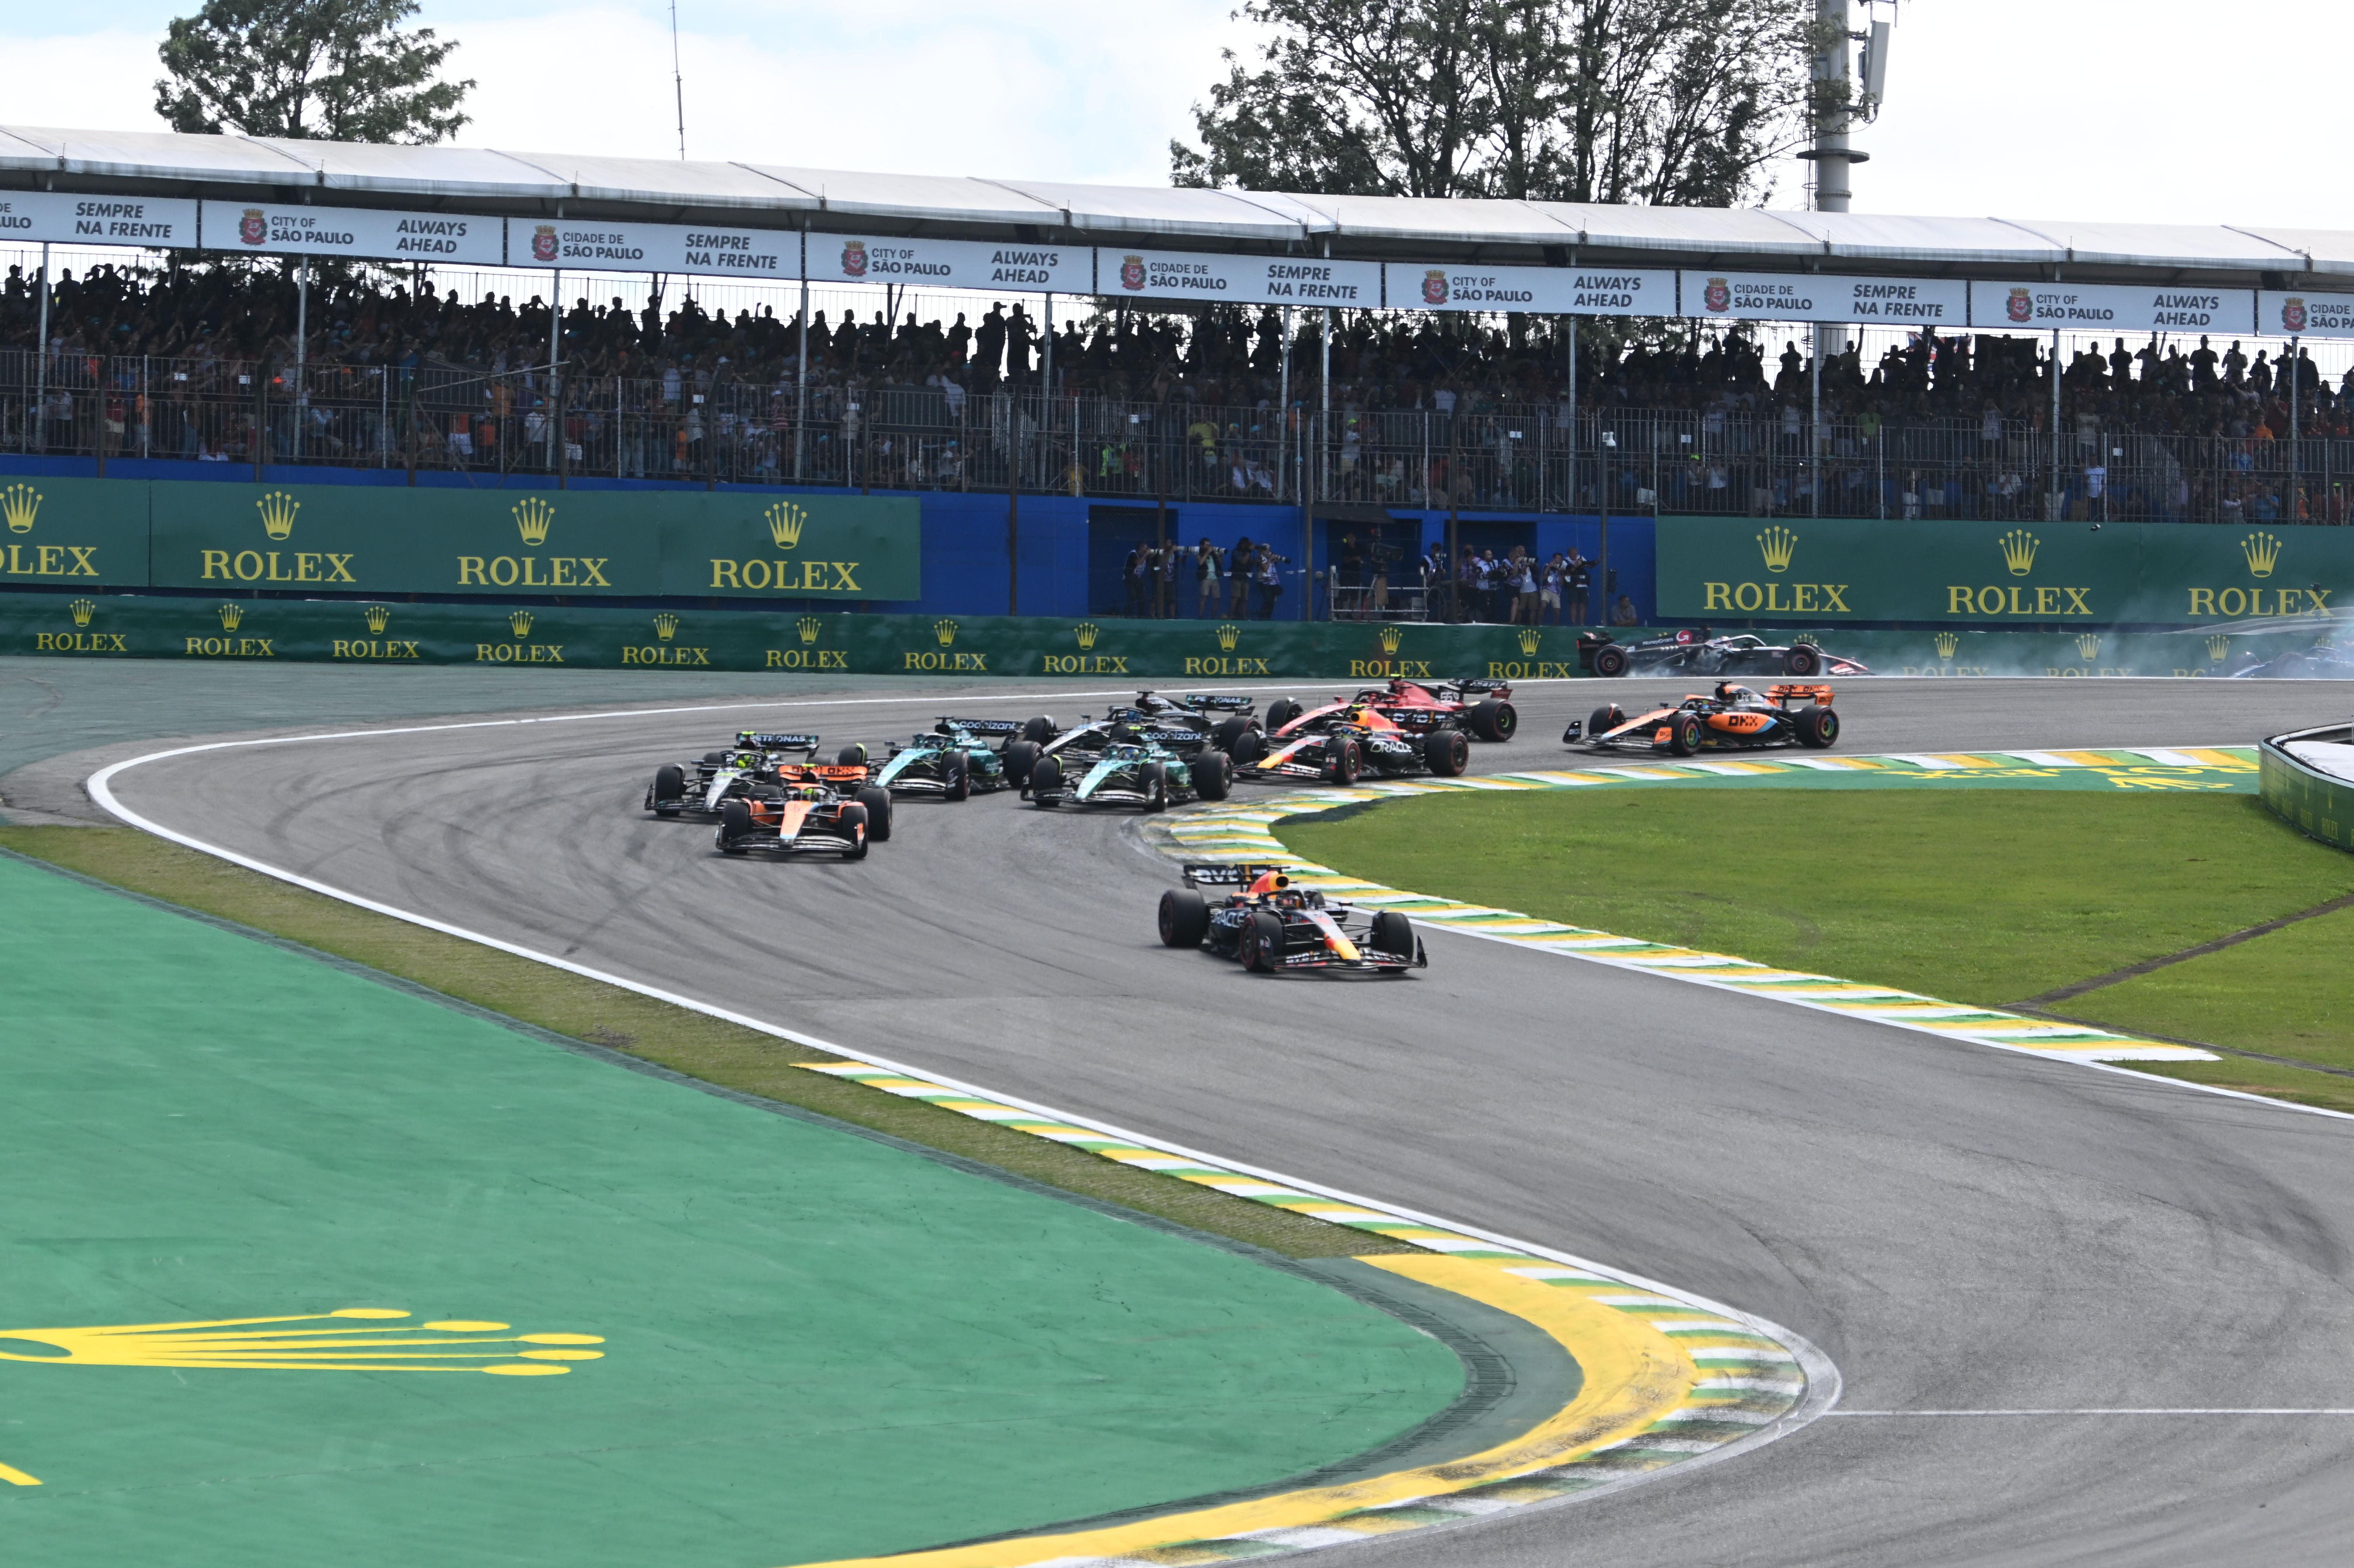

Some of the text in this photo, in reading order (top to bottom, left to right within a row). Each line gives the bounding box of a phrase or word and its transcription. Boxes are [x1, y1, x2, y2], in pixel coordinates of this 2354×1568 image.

[75, 202, 144, 219] SEMPRE
[75, 220, 172, 238] NA FRENTE
[271, 216, 316, 228] CITY OF
[396, 219, 467, 237] ALWAYS
[271, 227, 354, 244] SÃO PAULO
[562, 232, 624, 244] CIDADE DE
[685, 233, 750, 250] SEMPRE
[396, 237, 457, 253] AHEAD
[563, 243, 644, 260] SÃO PAULO
[871, 248, 914, 259] CITY OF
[685, 251, 777, 269] NA FRENTE
[991, 250, 1058, 267] ALWAYS
[872, 259, 951, 276] SÃO PAULO
[991, 268, 1049, 283] AHEAD
[1150, 262, 1208, 275] CIDADE DE
[1267, 265, 1331, 281] SEMPRE
[1150, 273, 1227, 290] SÃO PAULO
[1452, 276, 1496, 287] CITY OF
[1573, 276, 1641, 291] ALWAYS
[1734, 284, 1793, 295] CIDADE DE
[1267, 282, 1358, 299] NA FRENTE
[1453, 287, 1533, 302] SÃO PAULO
[1853, 284, 1917, 299] SEMPRE
[1573, 293, 1632, 307] AHEAD
[1735, 294, 1813, 310] SÃO PAULO
[2036, 294, 2078, 305] CITY OF
[2153, 294, 2219, 310] ALWAYS
[1853, 301, 1943, 317] NA FRENTE
[2036, 305, 2114, 320] SÃO PAULO
[2310, 304, 2351, 315] CIDADE
[2153, 312, 2210, 326] AHEAD
[2311, 314, 2339, 328] SÃO
[0, 544, 99, 576] LEX
[201, 550, 356, 582] ROLEX
[458, 556, 611, 586] ROLEX
[710, 559, 861, 591] ROLEX
[1704, 582, 1851, 612] ROLEX
[1948, 586, 2093, 615] ROLEX
[2189, 587, 2332, 616] ROLEX
[37, 633, 127, 651] ROLEX
[186, 637, 274, 656] ROLEX
[333, 640, 419, 658] ROLEX
[1642, 637, 1674, 646] MoneyGram
[476, 644, 564, 662] ROLEX
[622, 646, 709, 664] ROLEX
[767, 650, 847, 668] ROLEX
[905, 652, 987, 671] ROLEX
[1043, 655, 1128, 673] ROLEX
[1185, 657, 1270, 675] ROLEX
[1350, 660, 1431, 678] ROLEX
[1489, 662, 1570, 679] ROLEX
[1440, 692, 1453, 702] 55
[1728, 715, 1759, 726] OKX
[1370, 741, 1412, 753] ORACLE
